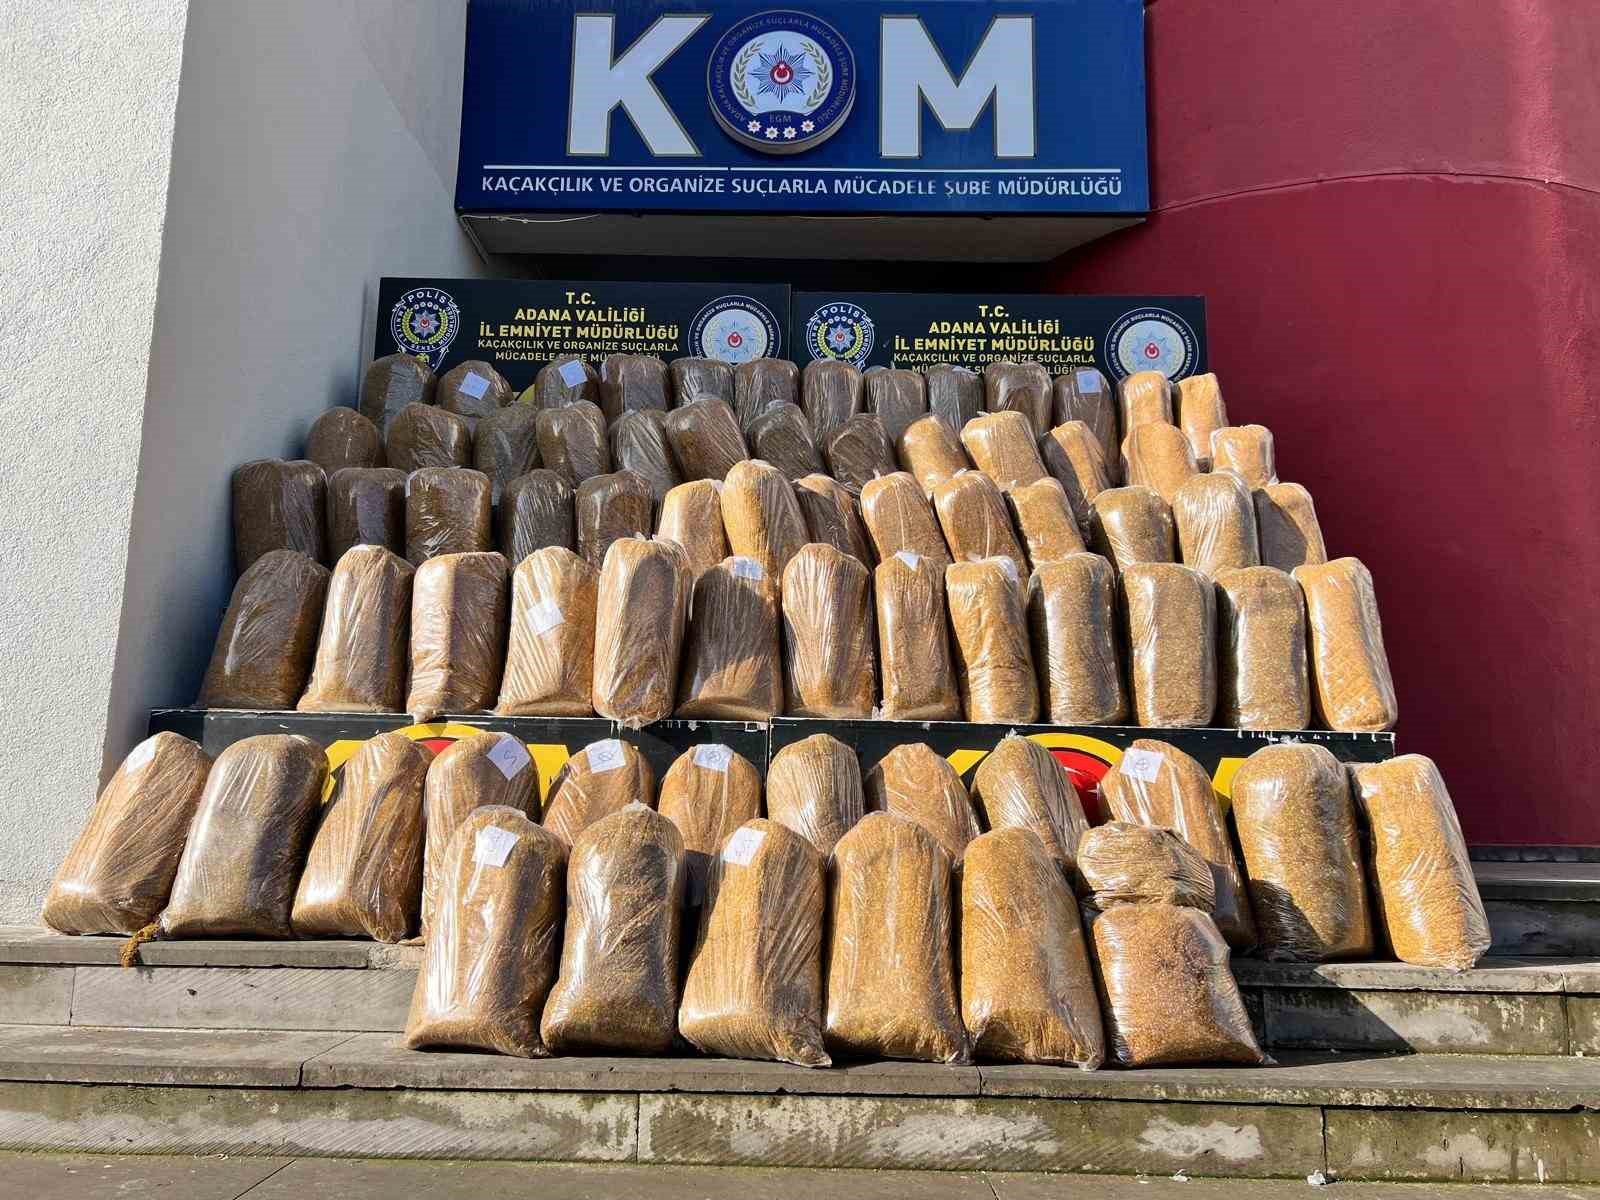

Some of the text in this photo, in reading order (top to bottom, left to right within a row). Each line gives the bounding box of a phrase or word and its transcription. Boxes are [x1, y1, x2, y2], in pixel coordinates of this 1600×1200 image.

[769, 114, 792, 123] EGM
[481, 173, 1122, 199] KAÇAKÇILIK VE ORGANİZE SUÇLARLA MÜCADELE ŞUBE MÜDÜRLÜĞÜ
[407, 290, 447, 304] POLİS
[565, 292, 596, 305] T.C.
[514, 307, 645, 323] ADANA VALİLİĞİ
[821, 306, 861, 318] POLİS
[978, 305, 1009, 318] T.C.
[480, 321, 680, 340] İL EMNİYET MÜDÜRLÜĞÜ
[928, 320, 1060, 335] ADANA VALİLİĞİ
[478, 339, 679, 353] KAÇAKÇILIK VE ORGANİZE SUÇLARLA
[895, 335, 910, 350] İL
[915, 335, 987, 351] EMNİYET
[991, 337, 1095, 352] MÜDÜRLÜĞÜ
[495, 351, 556, 361] MÜCADELE
[894, 352, 1096, 365] KAÇAKÇILIK VE ORGANİZE SUÇLARLA
